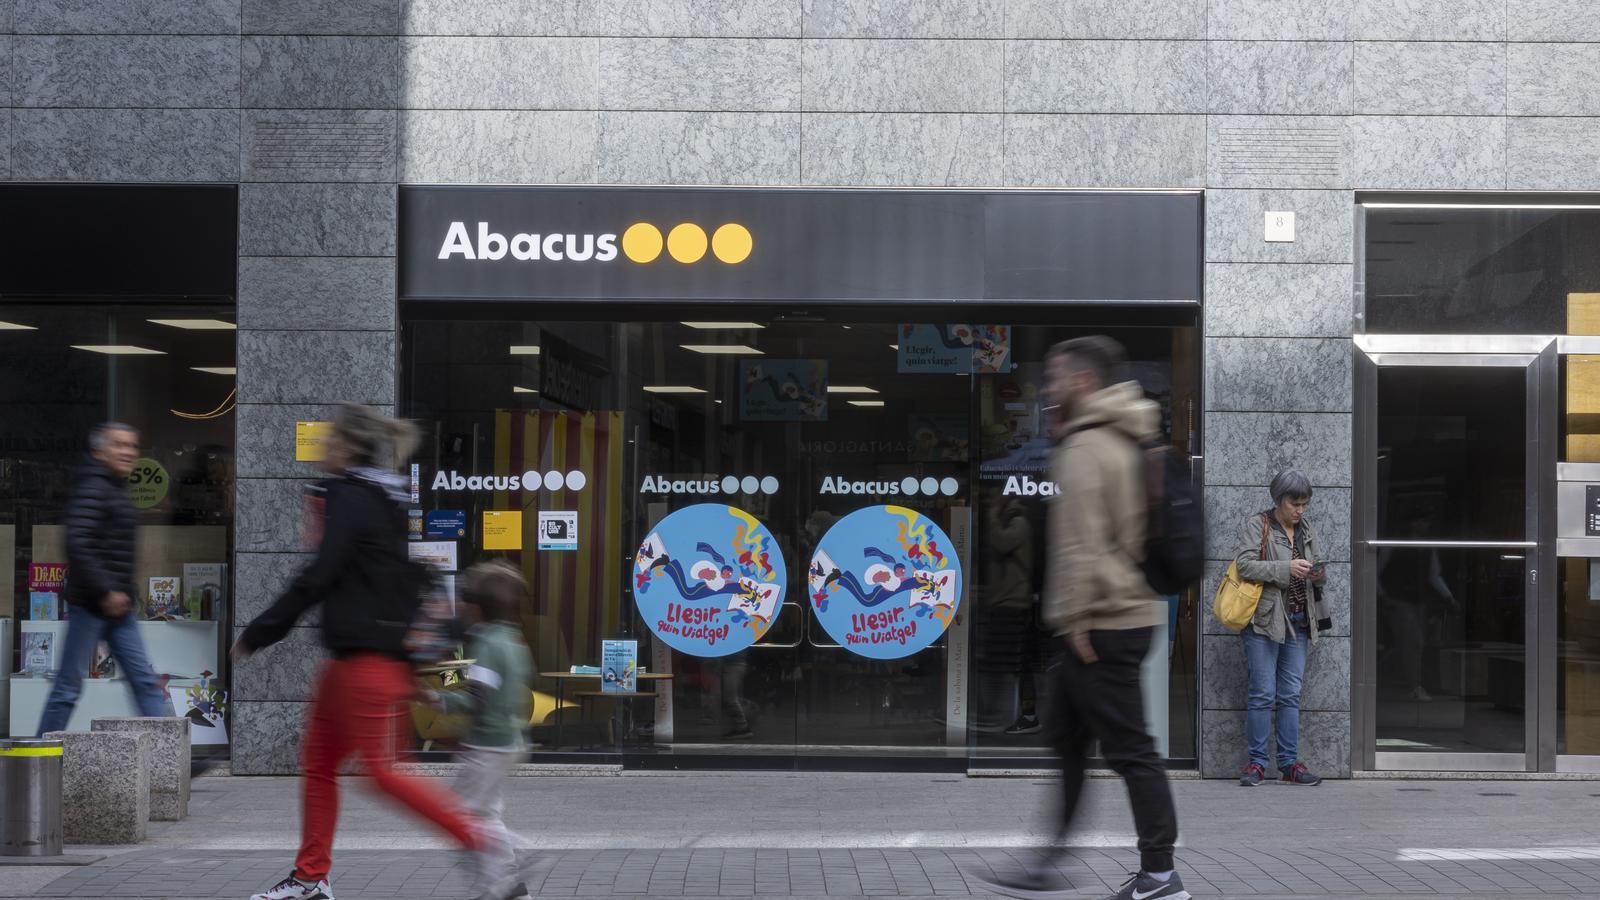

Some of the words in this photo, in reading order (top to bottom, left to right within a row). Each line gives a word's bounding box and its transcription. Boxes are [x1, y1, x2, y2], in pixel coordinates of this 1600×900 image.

[1276, 216, 1284, 227] 8
[437, 221, 618, 262] Abacus
[431, 470, 520, 491] Abacus
[640, 475, 720, 495] Abacus
[819, 476, 899, 496] Abacus
[667, 602, 721, 625] Llegir,
[851, 606, 905, 633] Llegir,
[657, 620, 680, 635] quin
[845, 632, 869, 645] quin
